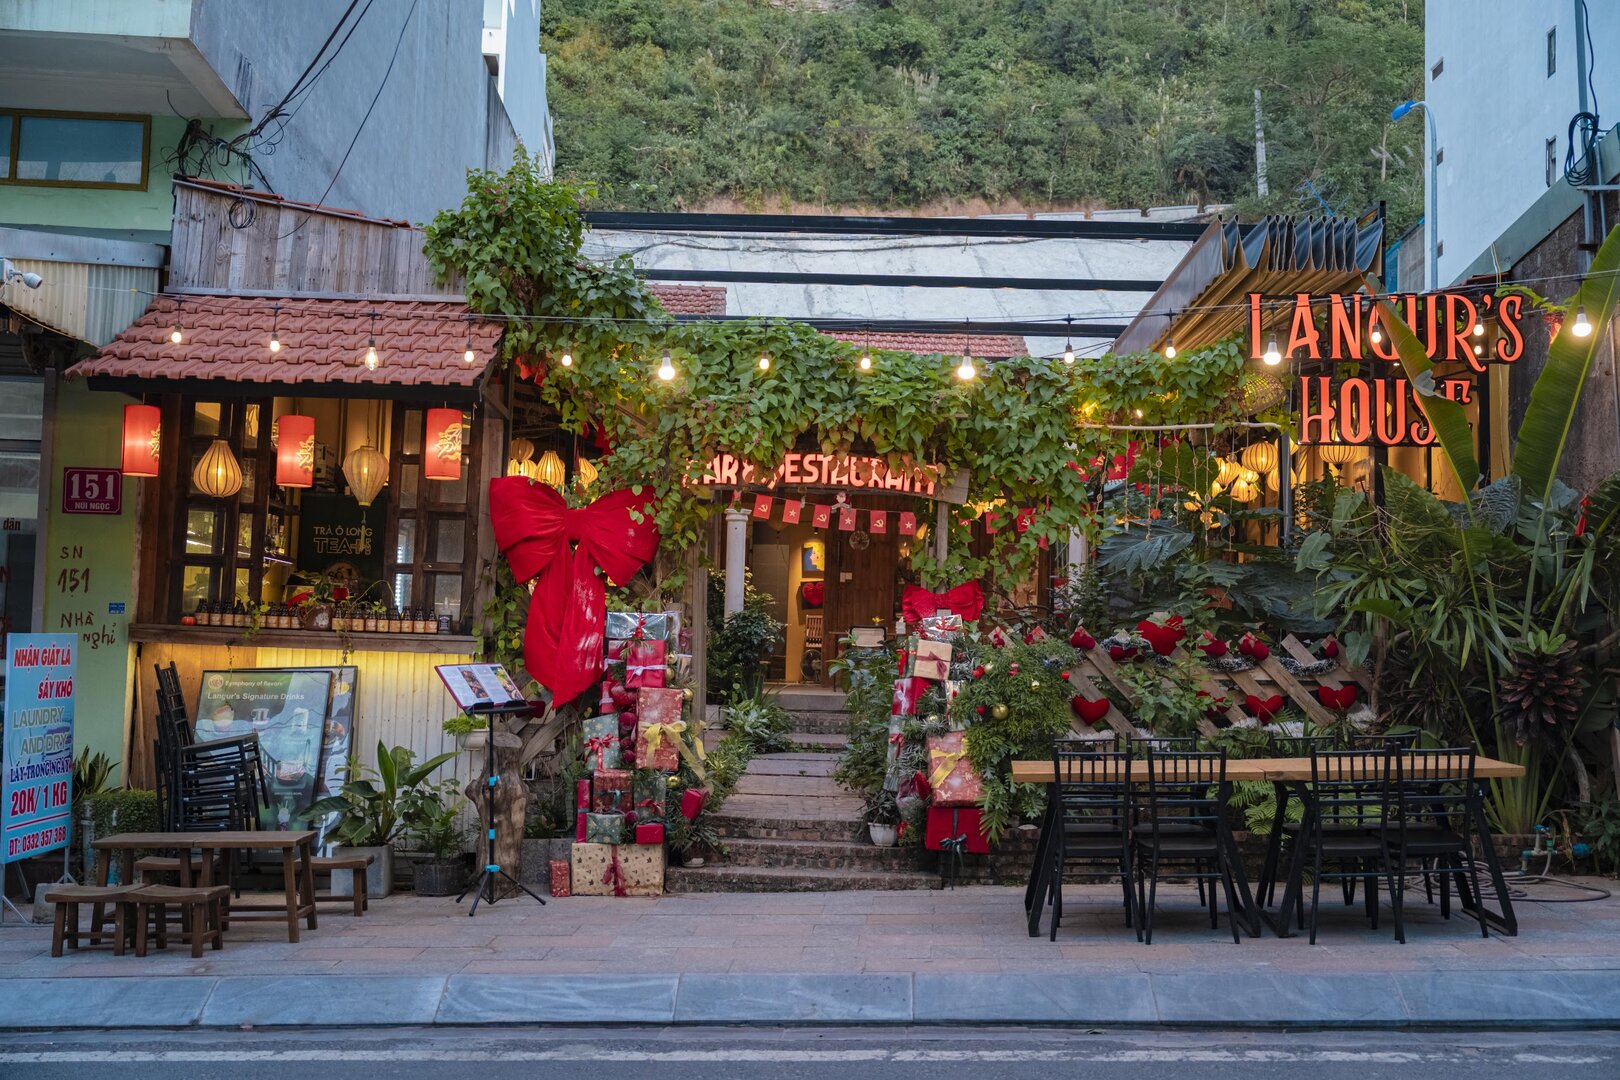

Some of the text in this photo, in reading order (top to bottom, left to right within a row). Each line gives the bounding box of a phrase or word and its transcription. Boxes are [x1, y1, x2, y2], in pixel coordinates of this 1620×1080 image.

[71, 473, 114, 500] 151
[313, 524, 333, 536] TRÀ
[60, 546, 83, 559] SN
[57, 567, 90, 594] 151
[60, 611, 94, 628] NHÀ
[14, 645, 39, 671] NHẬN
[38, 673, 73, 699] SẤY KHÔ
[242, 692, 279, 702] Signature
[280, 692, 305, 700] Drinks
[13, 706, 64, 729] LAUNDRY
[21, 733, 68, 756] AND DRY
[52, 781, 68, 807] KG
[22, 832, 39, 852] 0332
[41, 828, 52, 847] 357
